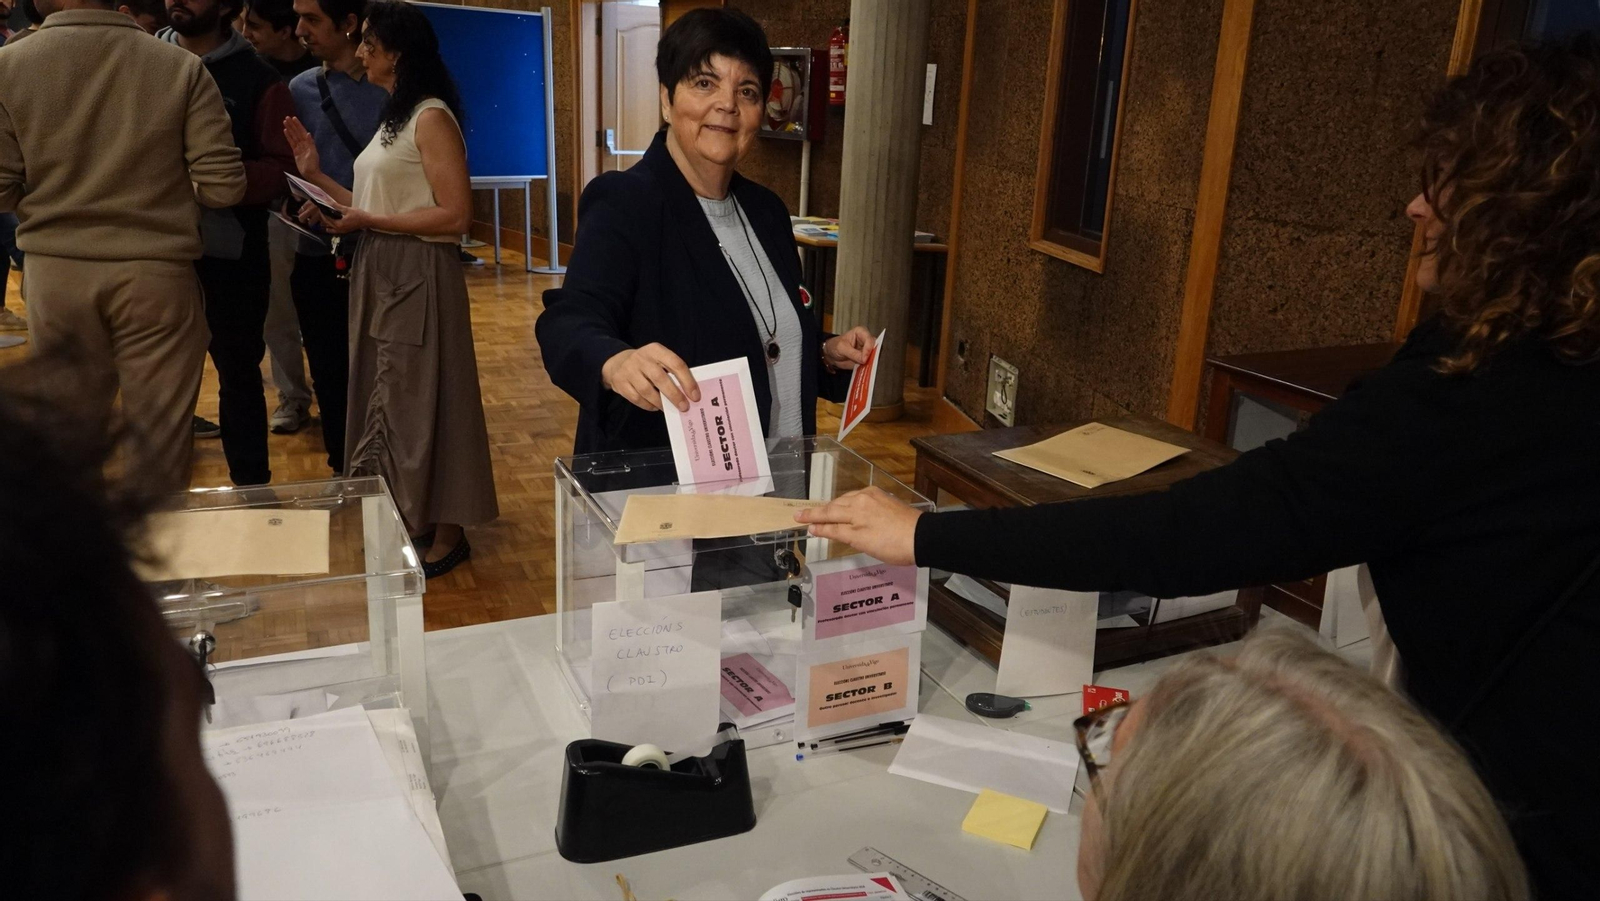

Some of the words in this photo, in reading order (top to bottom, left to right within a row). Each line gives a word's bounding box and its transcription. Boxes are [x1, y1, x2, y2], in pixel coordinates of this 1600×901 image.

[711, 396, 720, 407] A
[714, 415, 733, 471] SECTOR
[833, 596, 884, 613] SECTOR
[890, 593, 900, 601] A
[609, 616, 683, 640] ELECCIÓNS
[617, 645, 683, 660] CLAUSTRO
[722, 668, 754, 693] SECTOR
[826, 686, 876, 702] SECTOR
[884, 682, 892, 690] B
